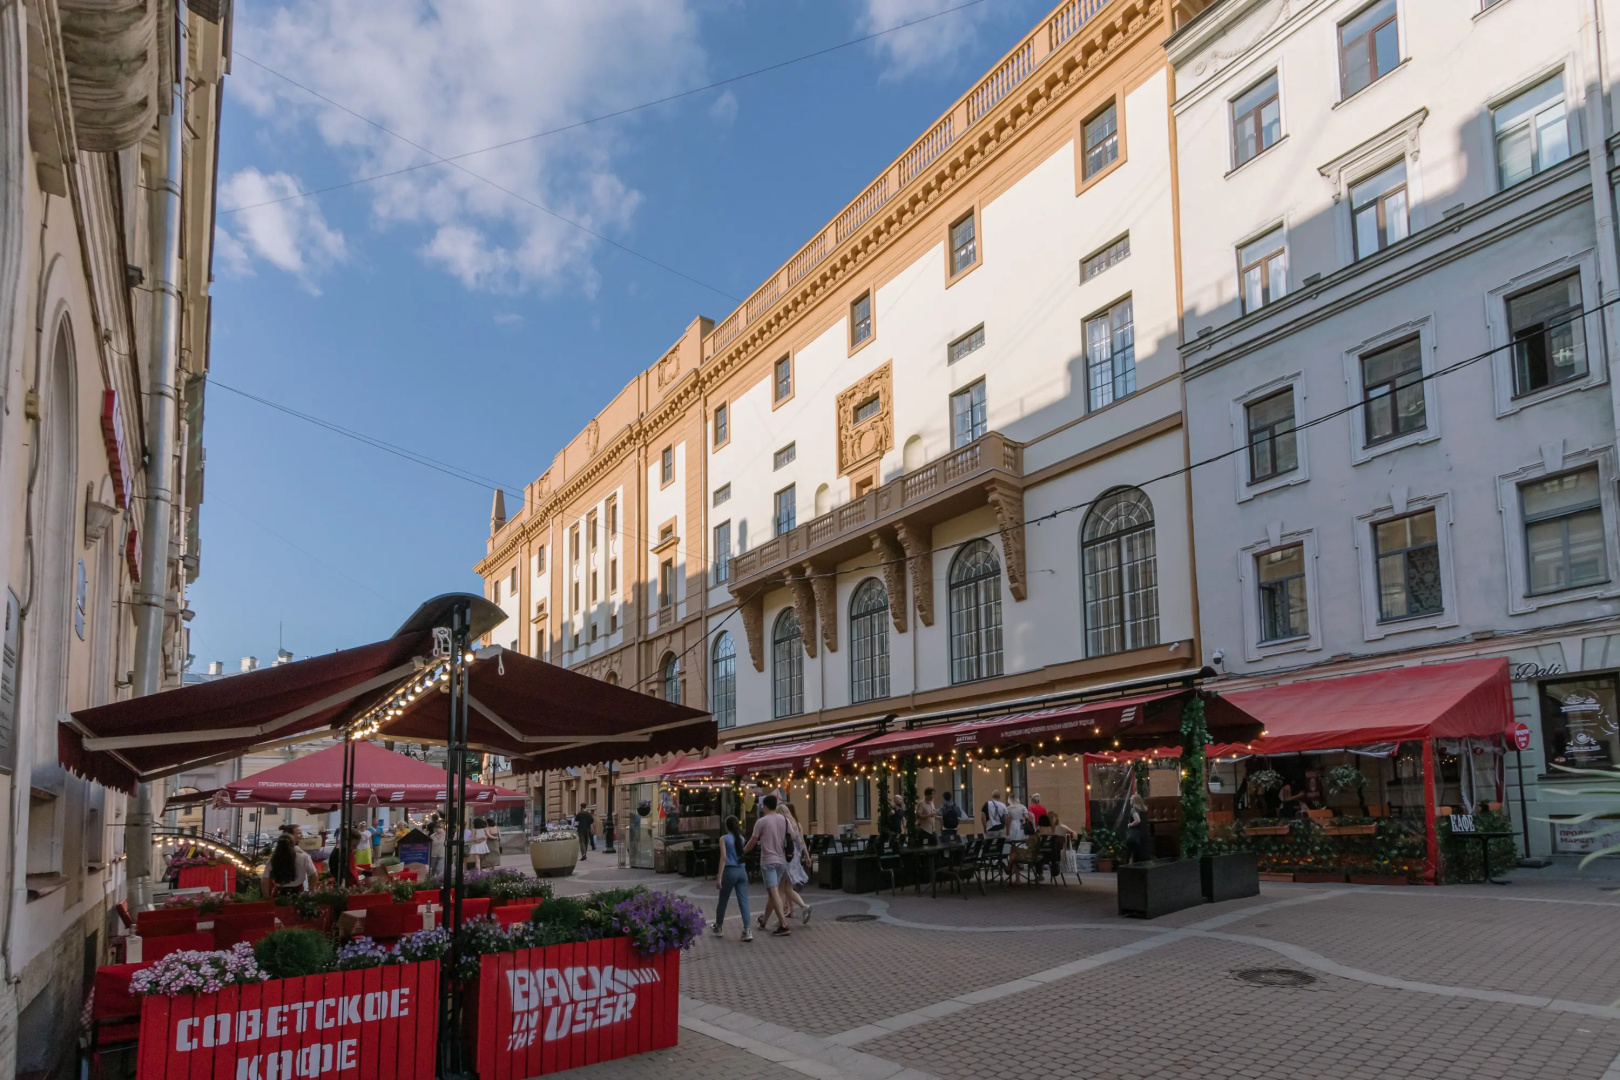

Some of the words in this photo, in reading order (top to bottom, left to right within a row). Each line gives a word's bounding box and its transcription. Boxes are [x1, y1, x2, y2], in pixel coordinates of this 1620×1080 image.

[1515, 662, 1561, 680] Dali
[1450, 814, 1476, 832] КАФЕ
[506, 965, 660, 1012] BACK
[176, 988, 410, 1051] СОВЕТСКОЕ
[512, 1010, 539, 1032] IN
[544, 992, 636, 1042] USSR
[507, 1029, 538, 1051] THE
[236, 1038, 357, 1080] КАФЕ
